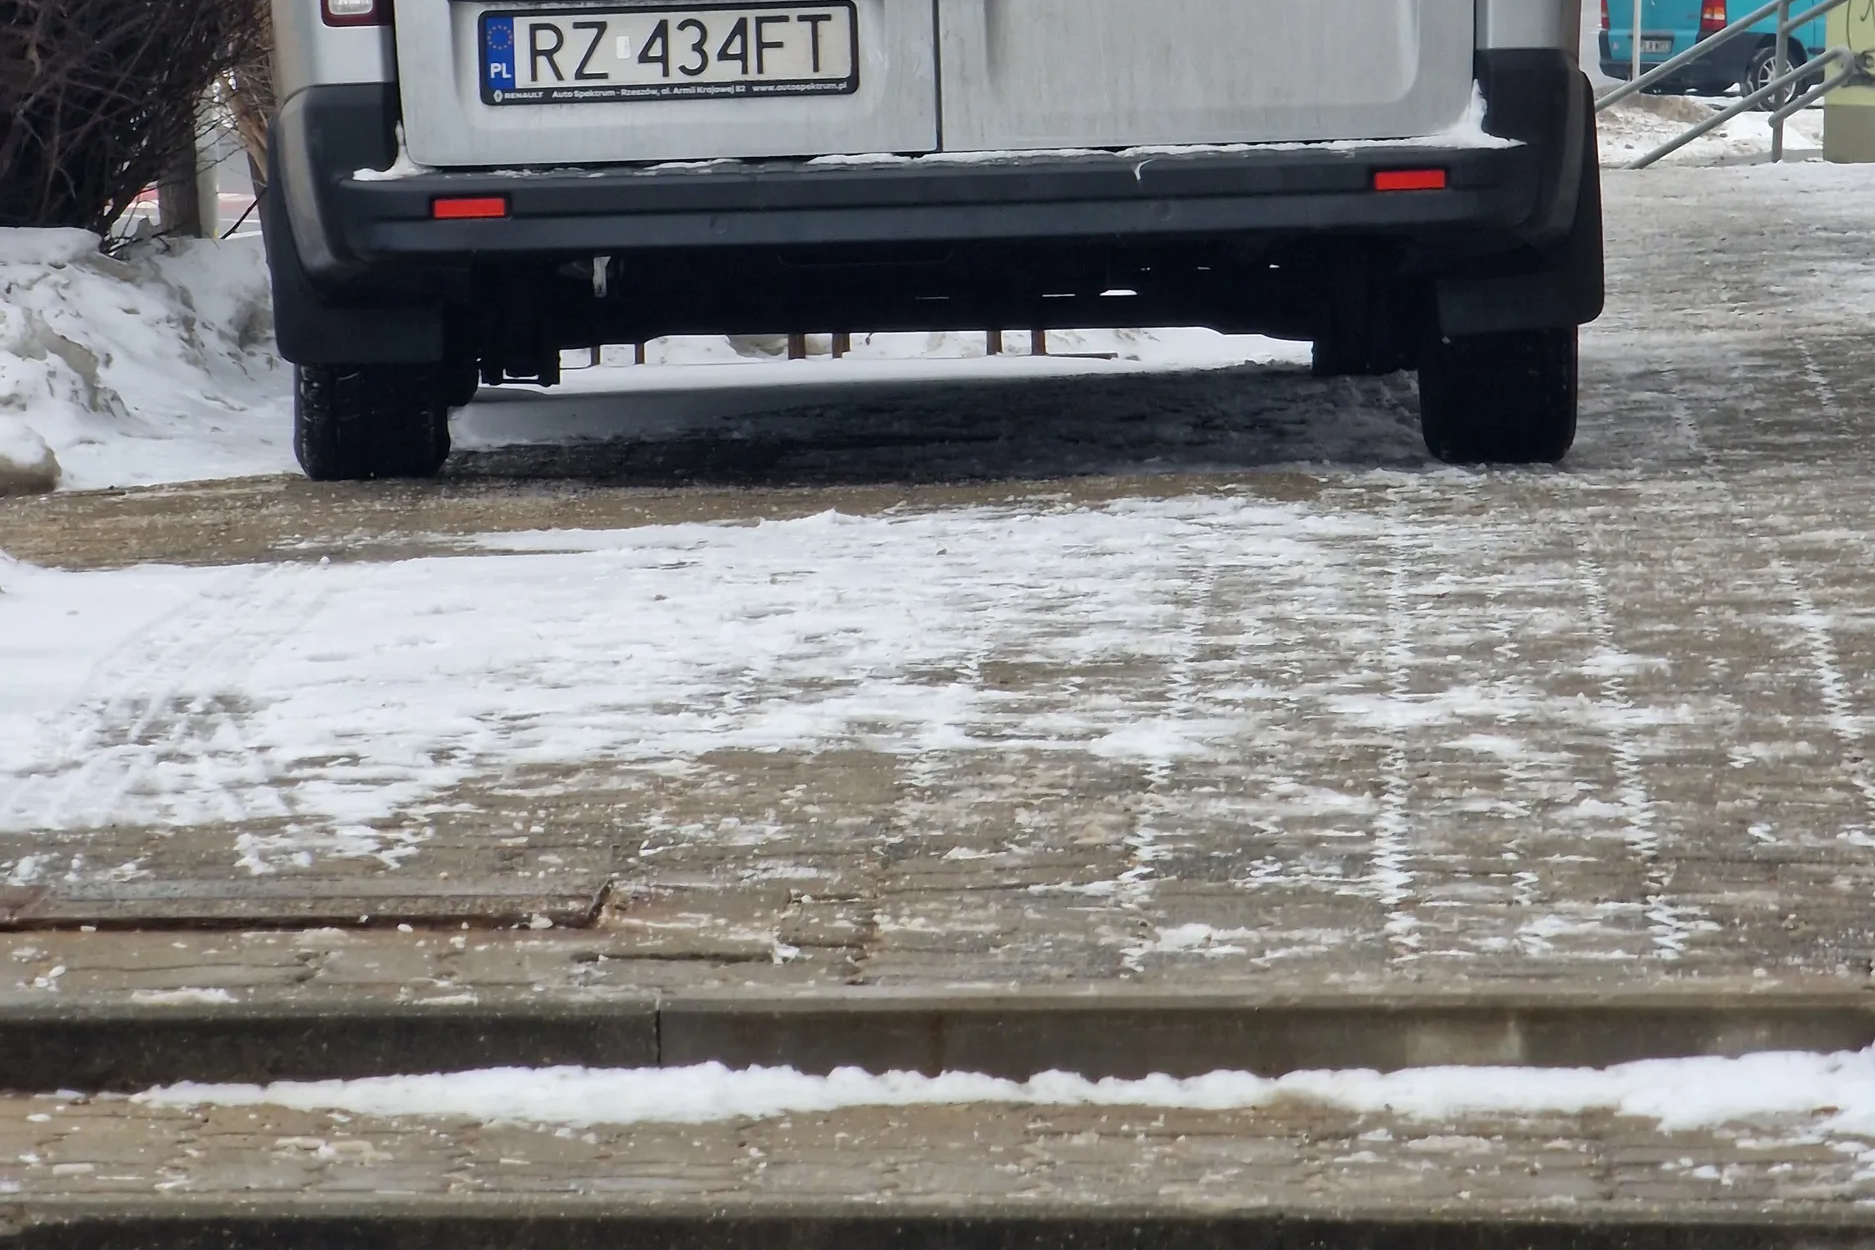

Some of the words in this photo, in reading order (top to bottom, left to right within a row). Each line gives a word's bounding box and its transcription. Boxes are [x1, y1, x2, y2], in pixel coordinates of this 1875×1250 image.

[529, 21, 609, 82] RZ
[637, 14, 832, 78] 434FT
[490, 62, 512, 79] PL
[504, 90, 544, 99] RENAULT
[552, 90, 574, 99] Auto
[574, 89, 616, 100] Spektrum
[752, 81, 848, 93] www.autospektrum.pl
